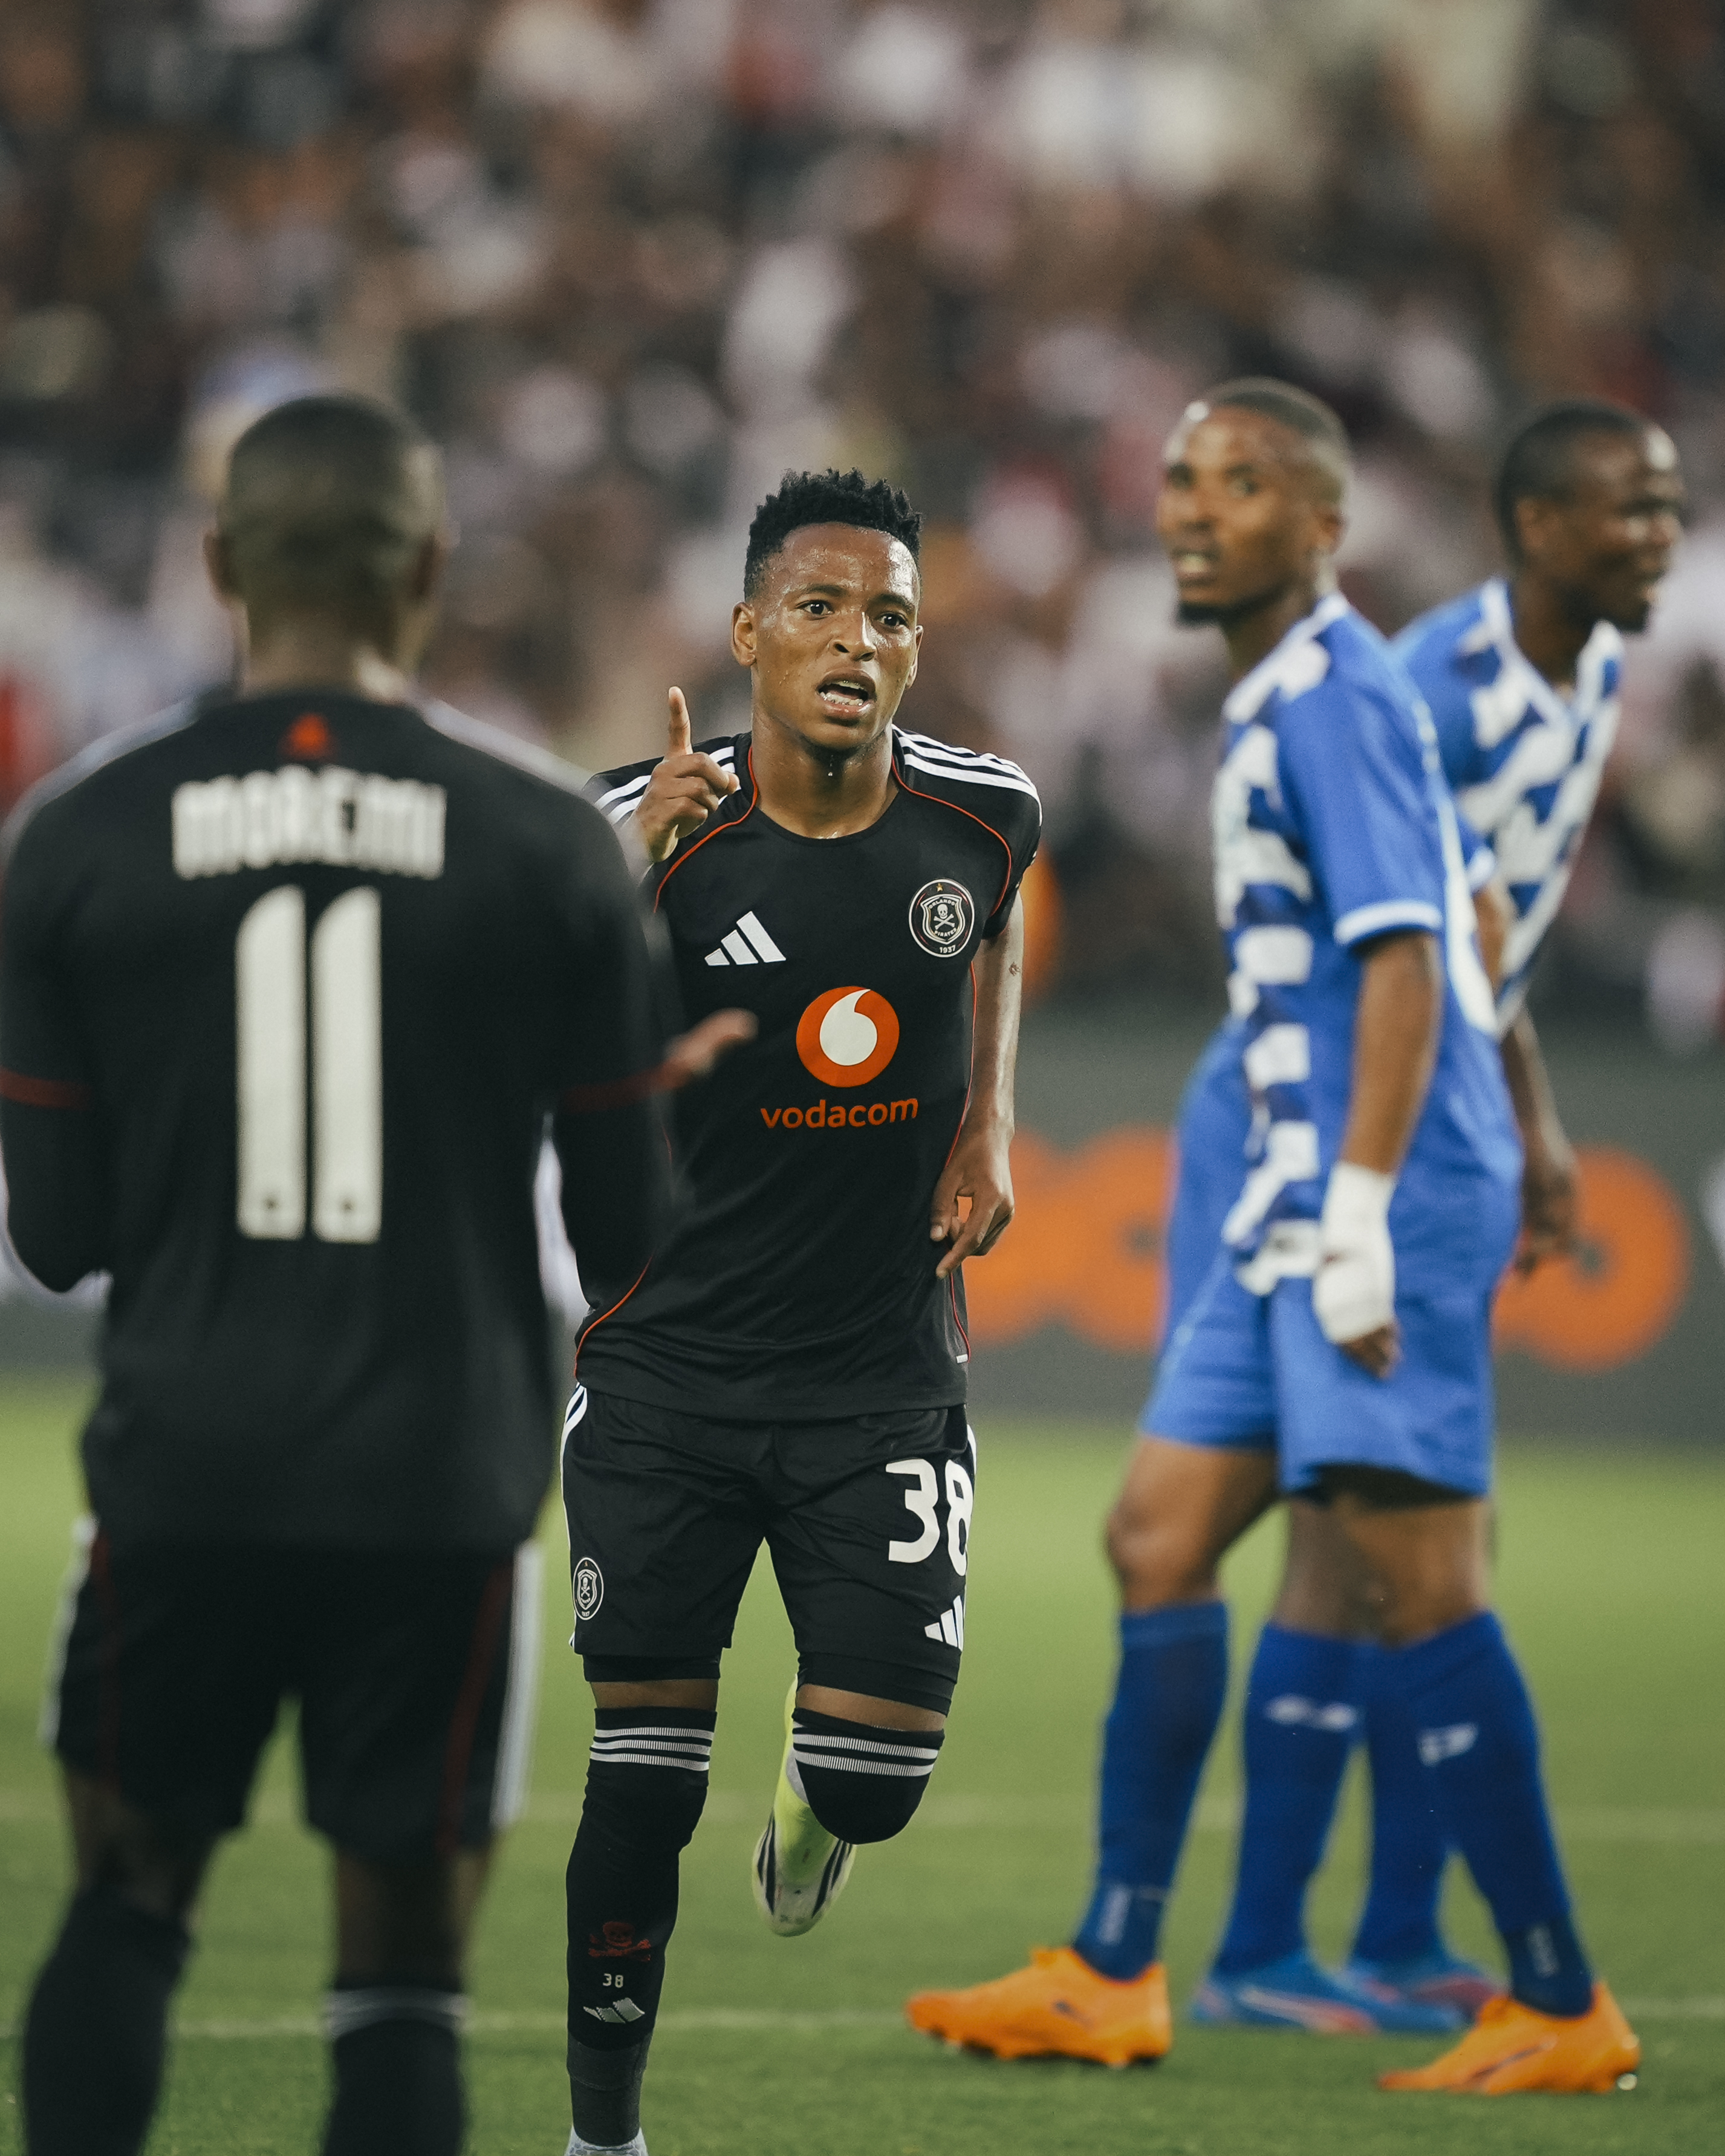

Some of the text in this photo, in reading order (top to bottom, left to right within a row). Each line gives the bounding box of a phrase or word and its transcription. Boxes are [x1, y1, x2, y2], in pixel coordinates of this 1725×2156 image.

[929, 899, 956, 909] ORLANDO
[934, 927, 957, 937] PIRATES
[939, 944, 956, 953] 1937
[236, 885, 382, 1243] 11
[760, 1098, 918, 1129] vodacom
[886, 1458, 973, 1577] 38
[603, 1973, 624, 1988] 38
